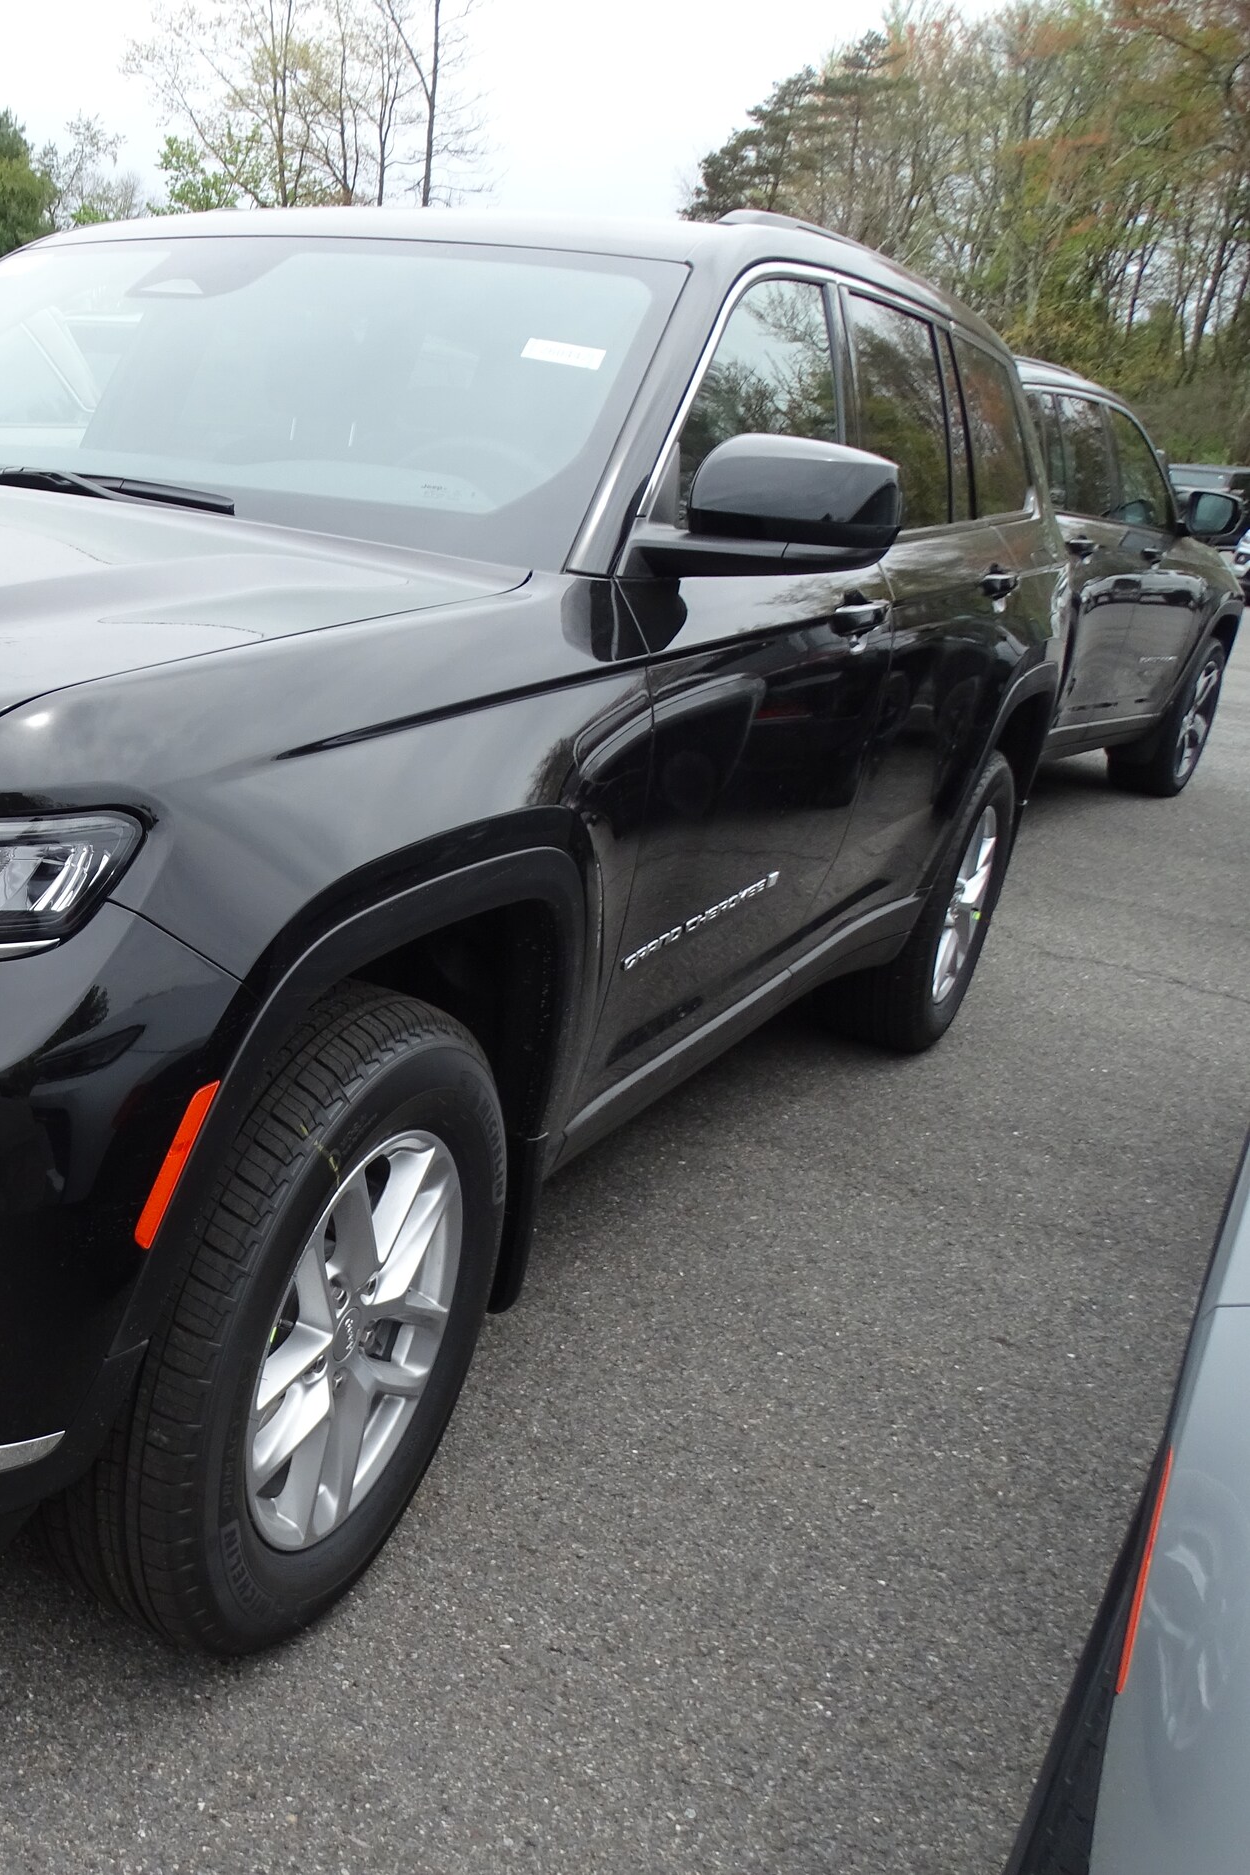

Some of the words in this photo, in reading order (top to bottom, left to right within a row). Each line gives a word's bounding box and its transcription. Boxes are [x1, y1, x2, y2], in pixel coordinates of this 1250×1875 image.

[622, 926, 682, 971] GRAND
[685, 878, 767, 932] CHEROKEE
[477, 1100, 504, 1199] MICHELIN
[223, 1419, 241, 1507] PRIMACY
[223, 1527, 272, 1618] MICHELIN
